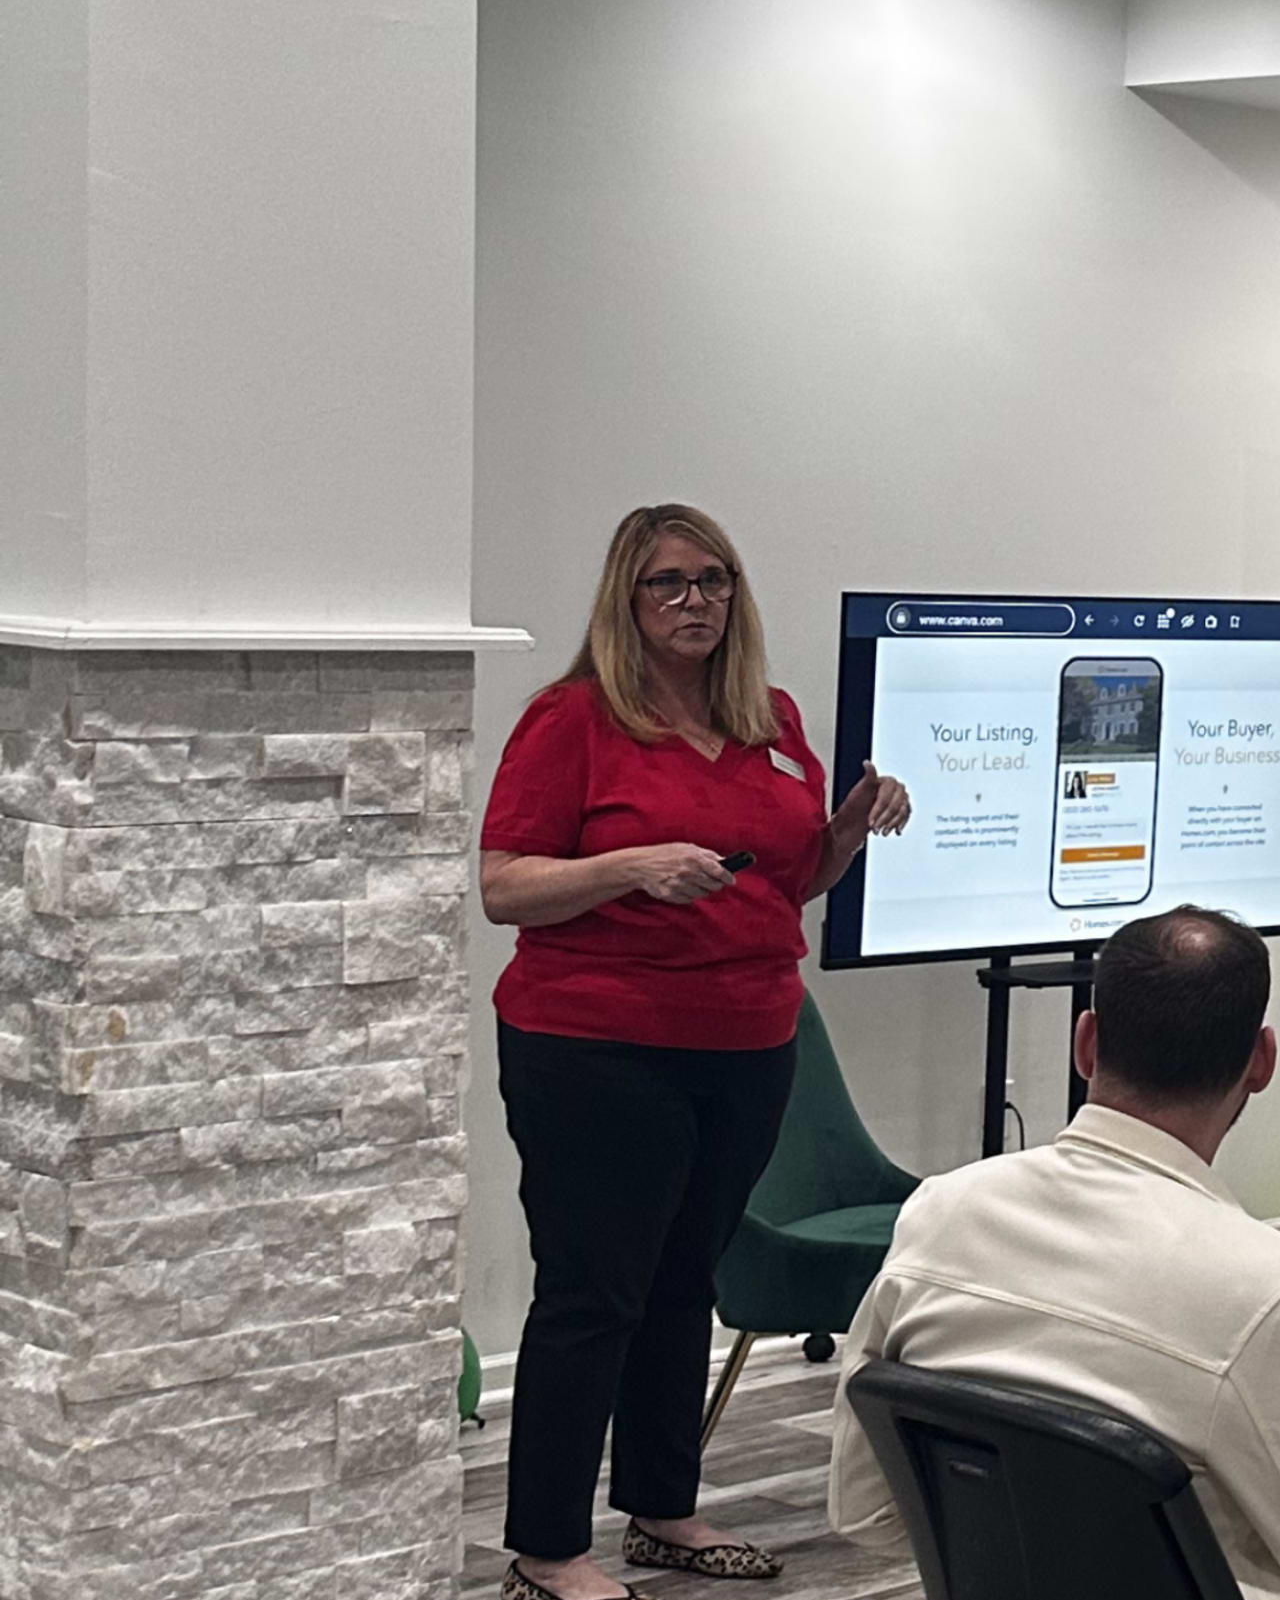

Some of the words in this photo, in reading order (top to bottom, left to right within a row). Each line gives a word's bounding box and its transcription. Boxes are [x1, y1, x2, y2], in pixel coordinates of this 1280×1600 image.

[919, 615, 1004, 627] www.canva.com
[930, 723, 972, 742] Your
[976, 723, 1038, 746] Listing,
[1187, 719, 1224, 738] Your
[1227, 719, 1274, 741] Buyer,
[936, 753, 978, 772] Your
[982, 751, 1030, 771] Lead.
[1174, 747, 1210, 766] Your
